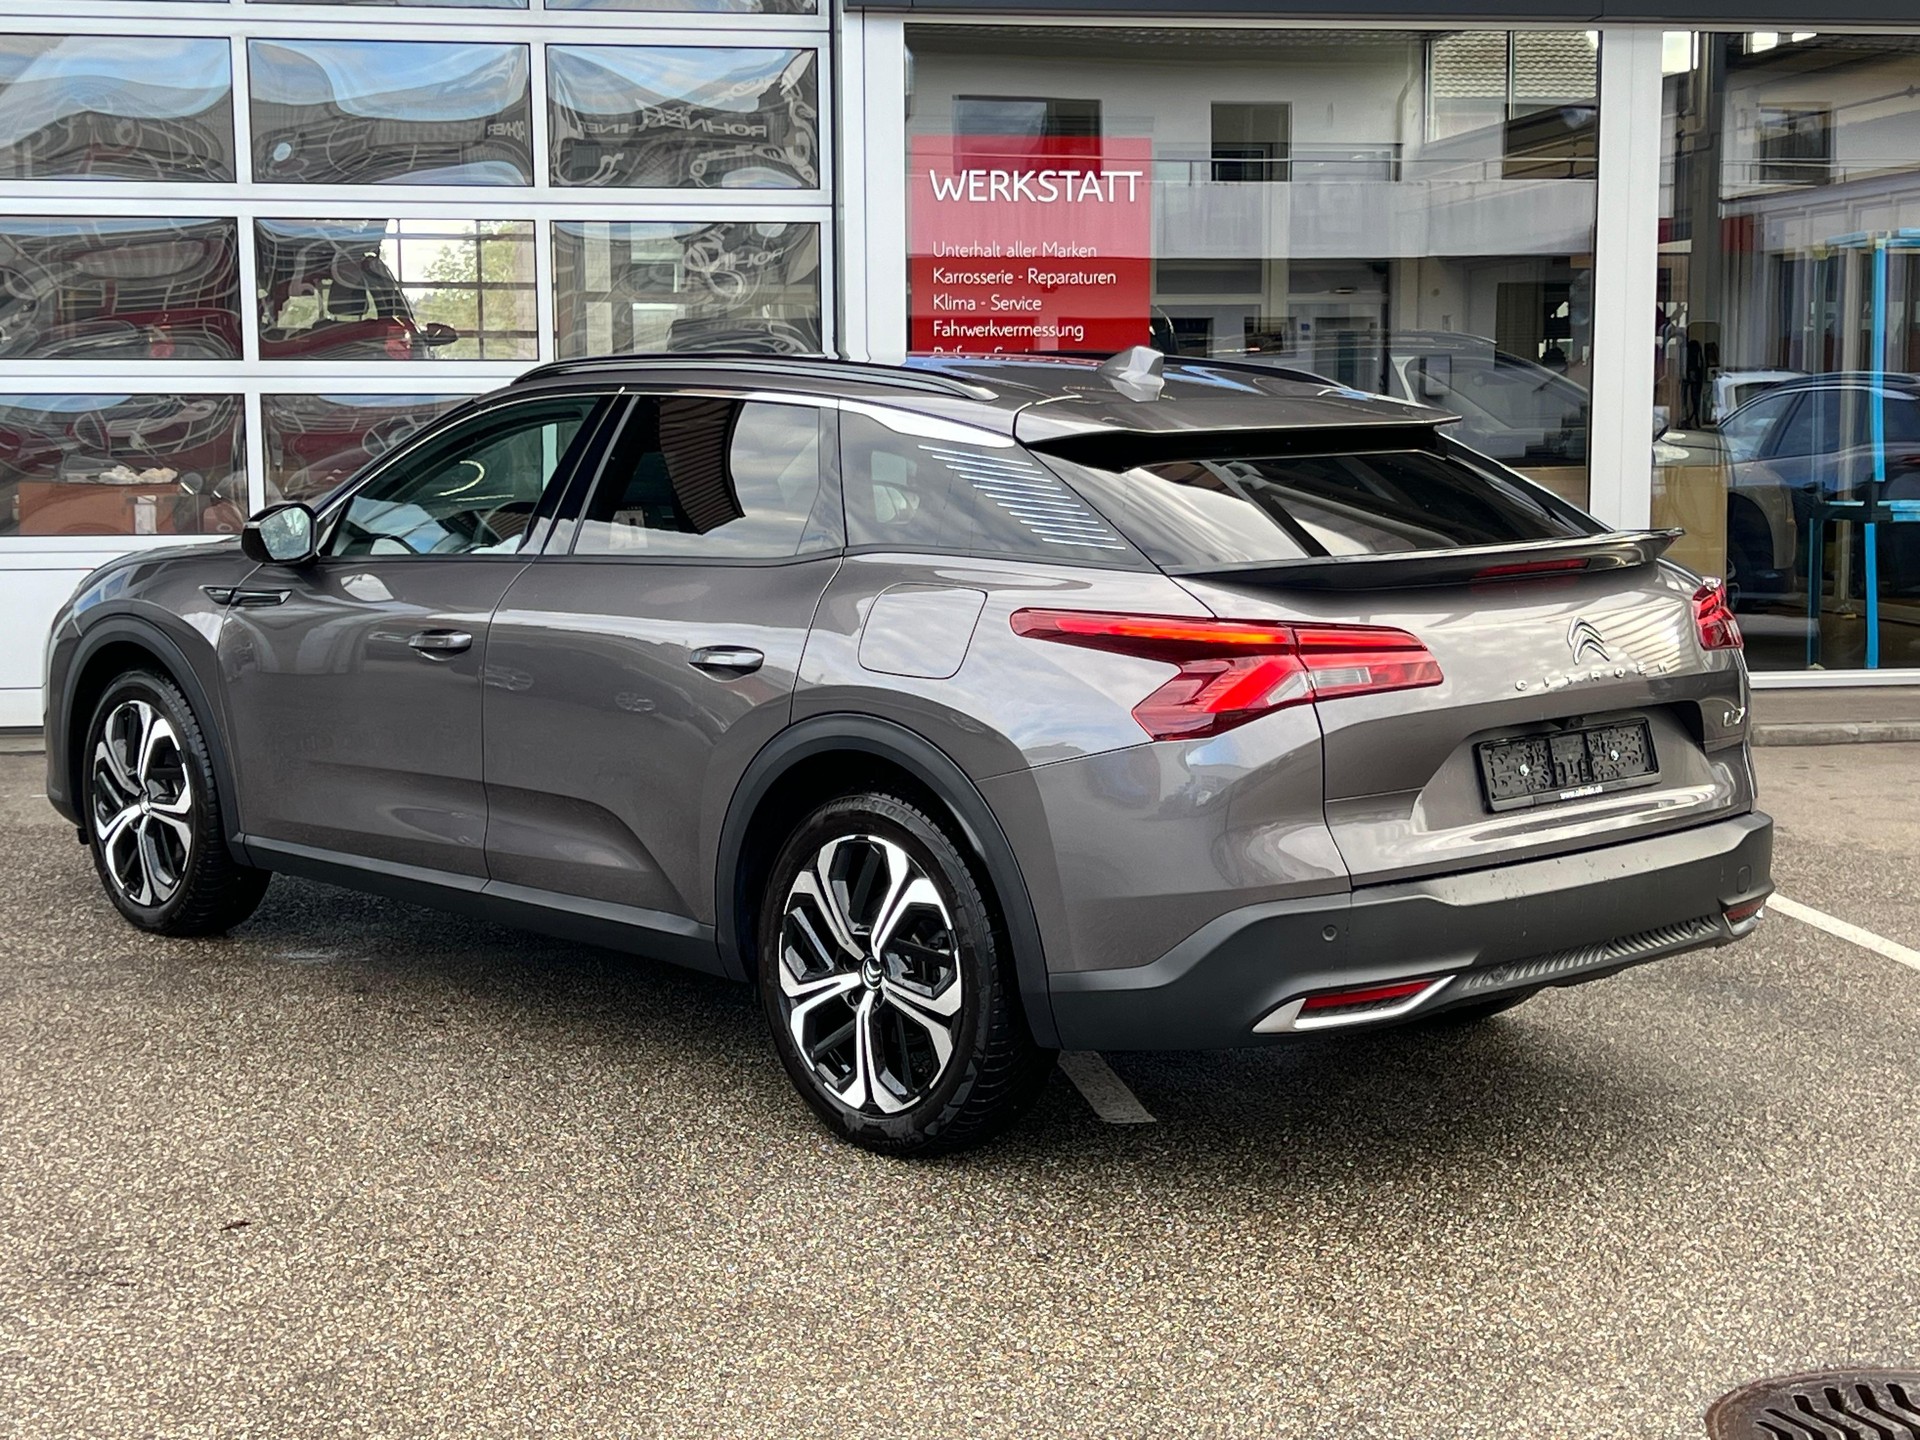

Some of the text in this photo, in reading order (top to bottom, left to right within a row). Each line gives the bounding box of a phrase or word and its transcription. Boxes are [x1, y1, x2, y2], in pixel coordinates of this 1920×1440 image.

[929, 169, 1143, 202] WERKSTATT
[933, 240, 1097, 258] Unterhalt aller Marken
[933, 267, 1013, 284] Karrosserie
[1027, 268, 1116, 287] Reparaturen
[933, 294, 975, 311] Klima
[991, 294, 1042, 311] Service
[933, 320, 1084, 341] Fahrwerkvermessung
